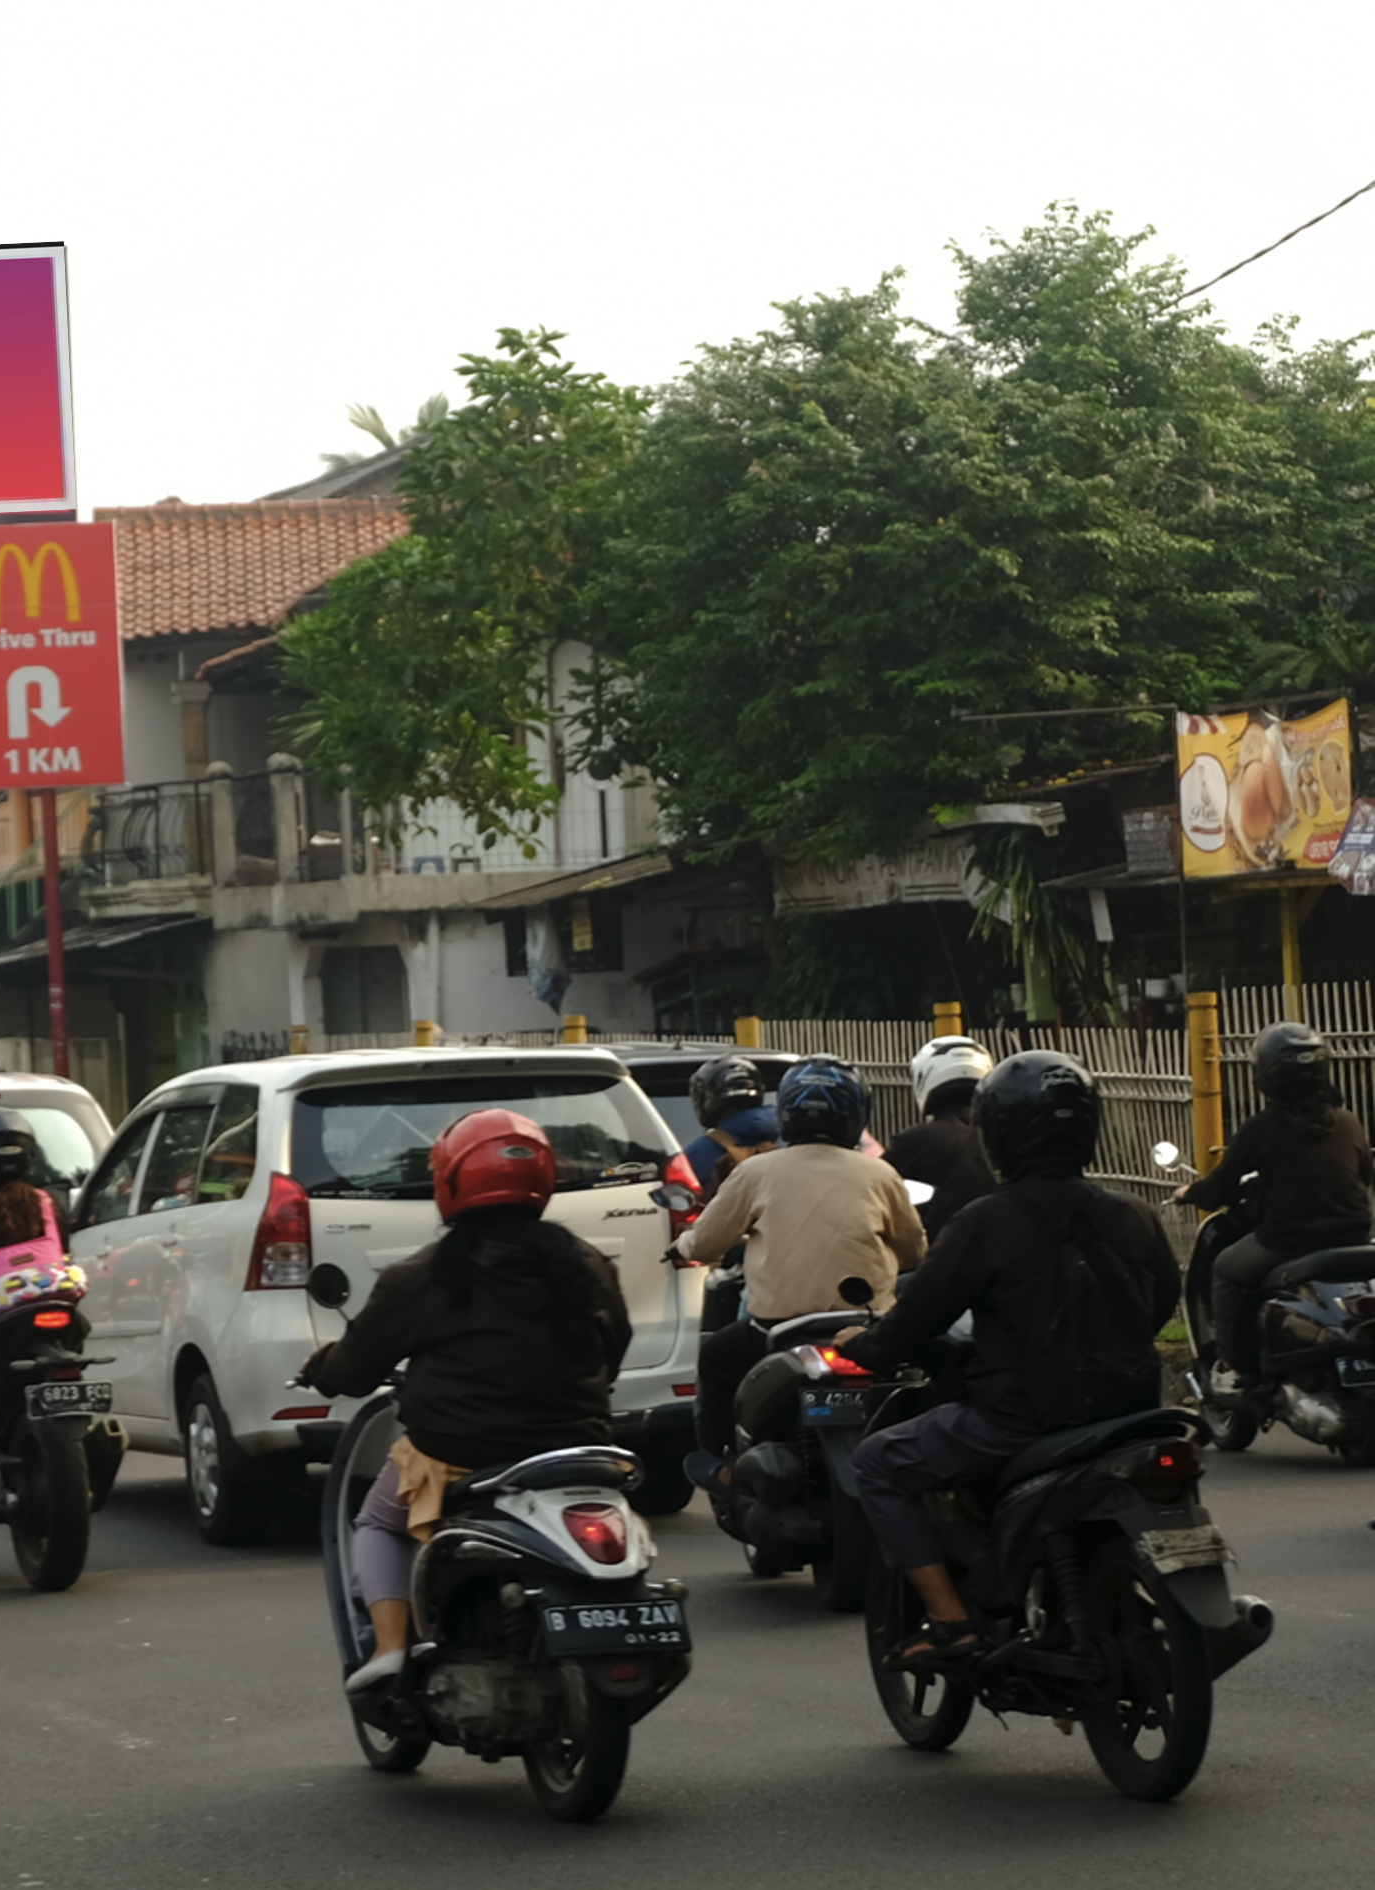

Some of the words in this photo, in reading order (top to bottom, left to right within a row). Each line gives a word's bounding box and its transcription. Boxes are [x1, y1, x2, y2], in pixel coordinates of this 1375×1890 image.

[39, 627, 97, 648] Thru
[4, 749, 20, 774] 1
[28, 747, 81, 773] KM
[550, 1612, 566, 1631] B
[578, 1608, 630, 1628] 6094
